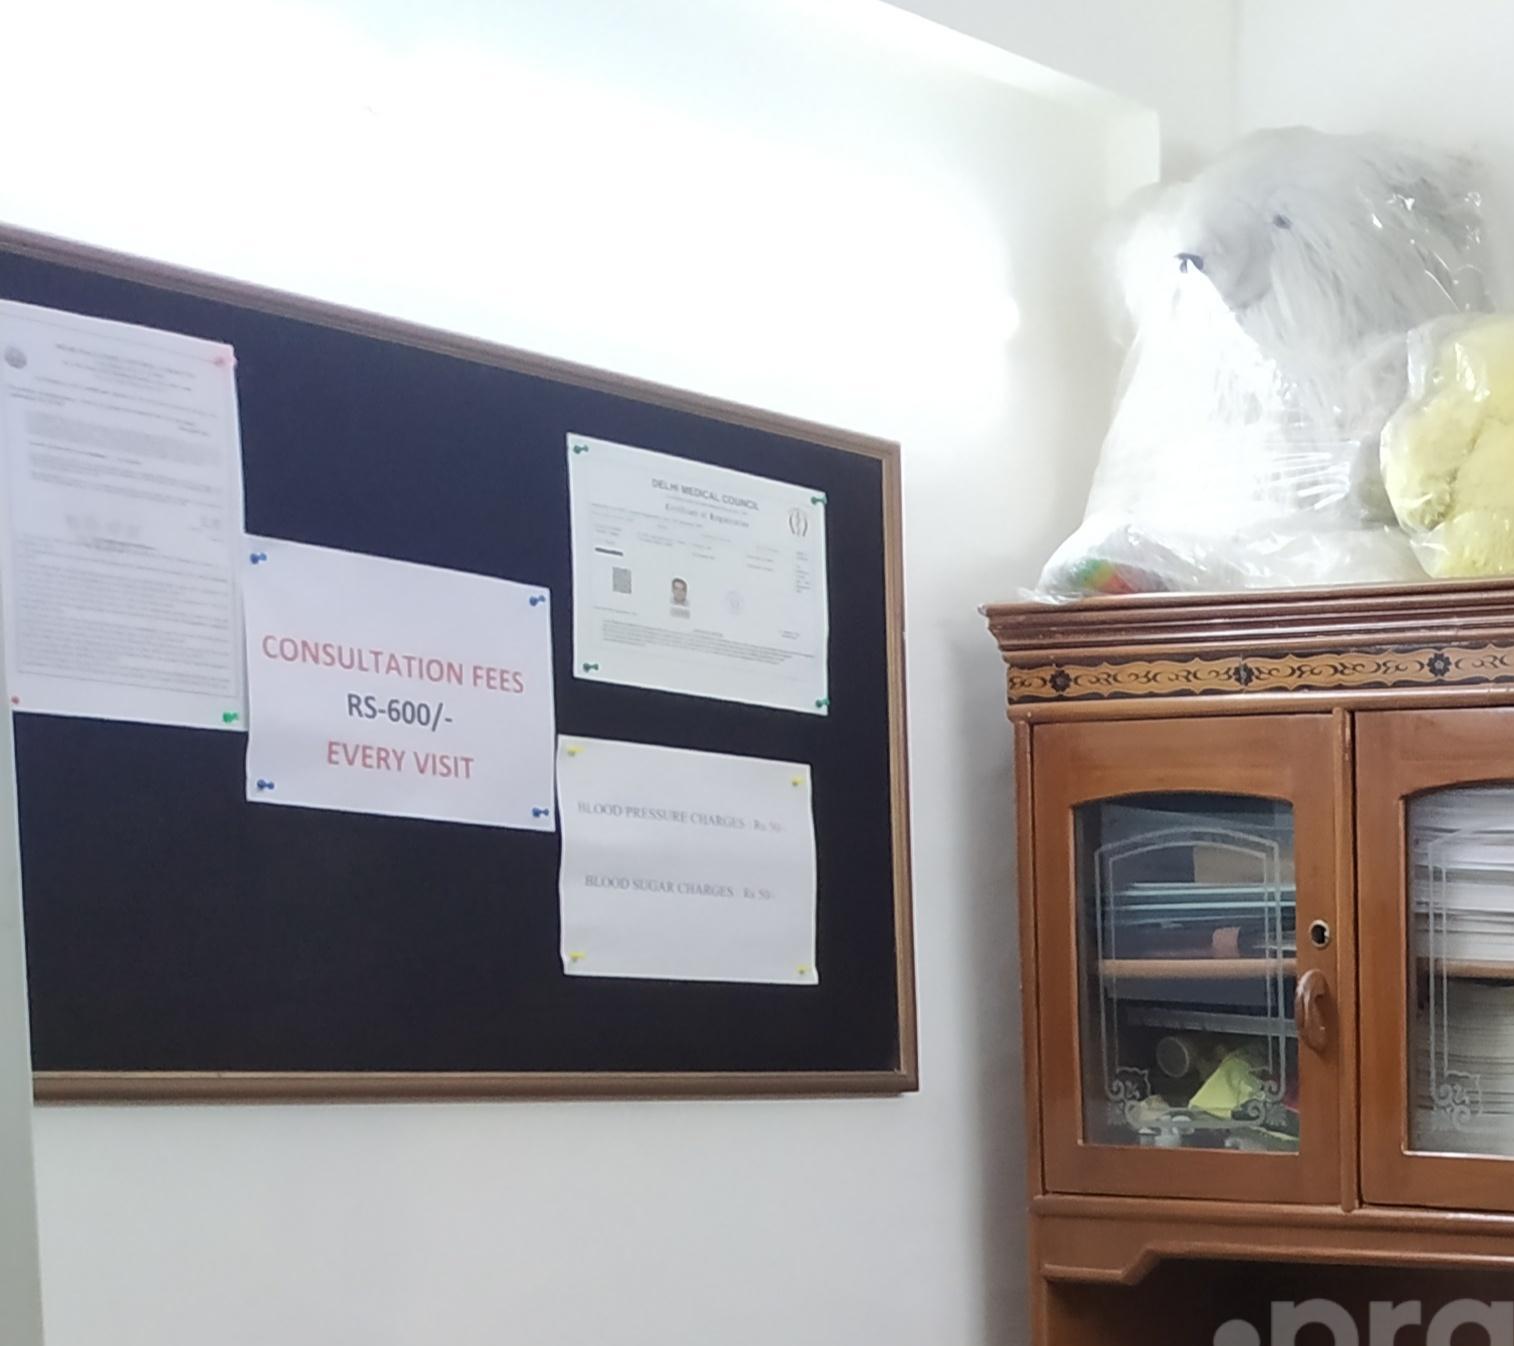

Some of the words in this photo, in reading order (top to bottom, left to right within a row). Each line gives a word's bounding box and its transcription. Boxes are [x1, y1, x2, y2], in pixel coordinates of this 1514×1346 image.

[652, 478, 679, 491] DELHI
[681, 485, 720, 502] MEDICAL
[722, 494, 759, 511] COUNCIL
[262, 635, 464, 686] CONSULTATION
[472, 665, 525, 694] FEES
[347, 694, 453, 732] RS-600/-
[327, 741, 406, 772] EVERY
[414, 751, 474, 779] VISIT
[577, 801, 623, 817] BLOOD
[625, 806, 688, 824] PRESSURE
[690, 812, 745, 829] CHARGES
[585, 875, 630, 890] BLOOD
[632, 879, 674, 893] SUGAR
[677, 882, 734, 898] CHARGES
